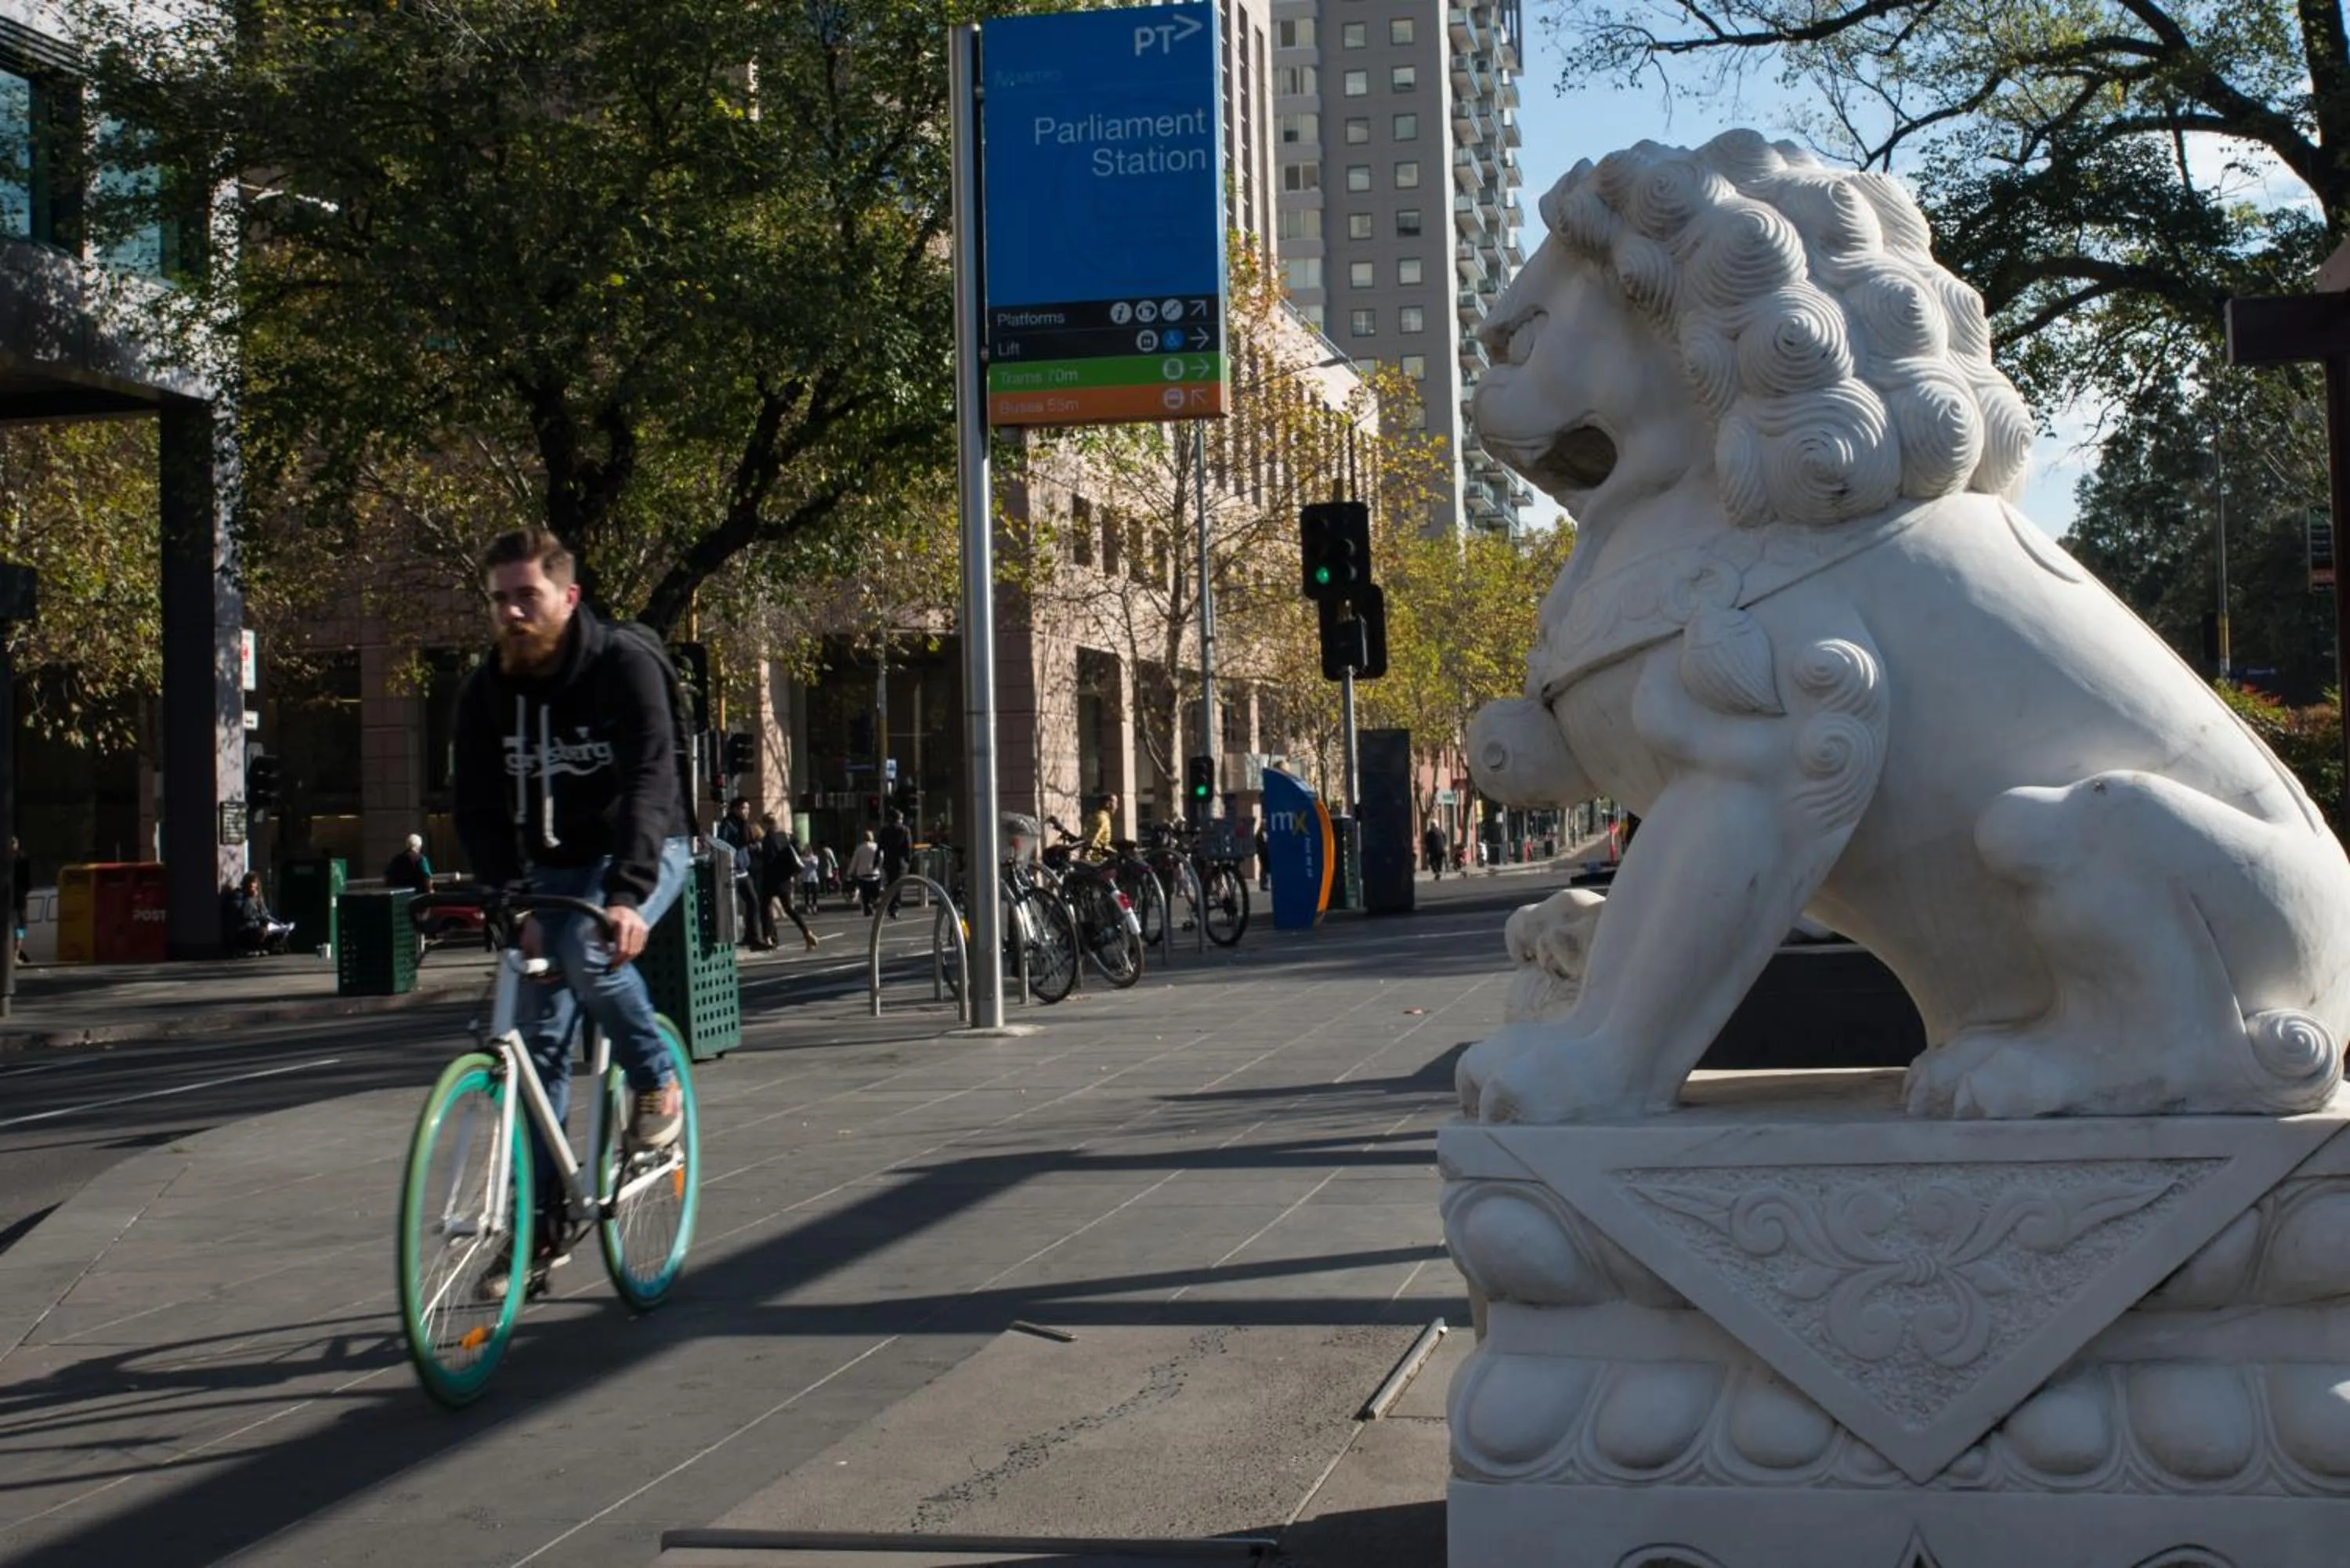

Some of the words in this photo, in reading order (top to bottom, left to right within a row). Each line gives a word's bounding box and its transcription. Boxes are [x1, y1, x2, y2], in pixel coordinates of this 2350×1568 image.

[1035, 108, 1206, 145] Parliament
[1092, 145, 1206, 176] Station
[997, 313, 1065, 327] Platforms
[997, 341, 1020, 356] Lift
[502, 735, 614, 775] Carsberg
[132, 909, 167, 923] POST
